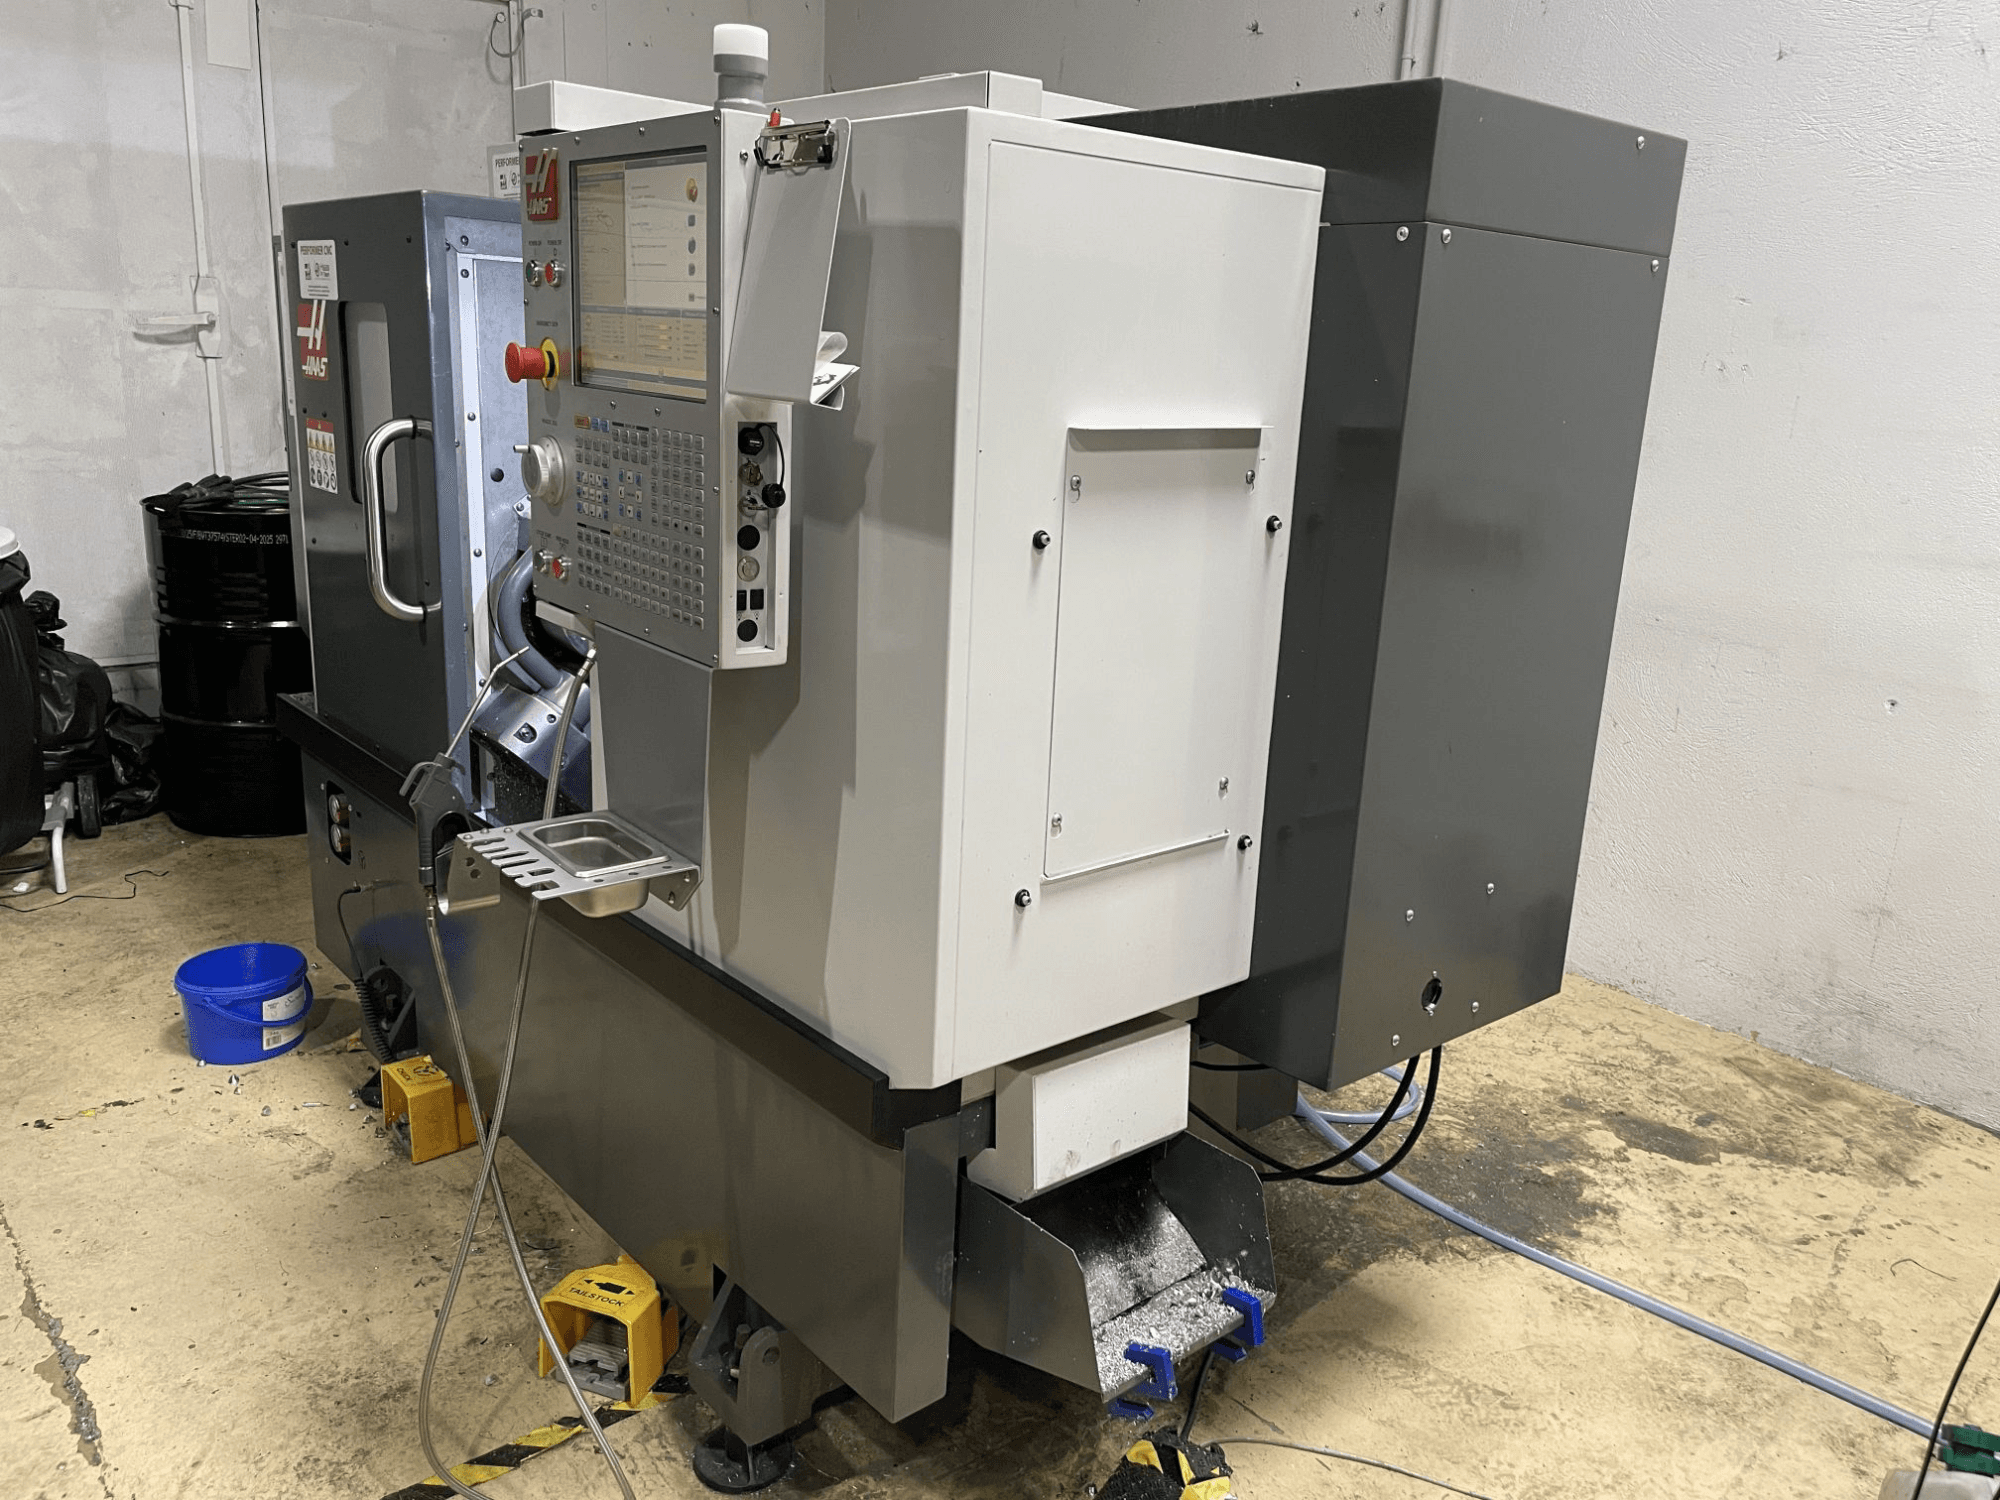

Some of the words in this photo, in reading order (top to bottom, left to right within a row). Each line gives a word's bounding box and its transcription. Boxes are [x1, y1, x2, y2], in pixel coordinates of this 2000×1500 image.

[495, 157, 520, 168] PERFORME
[302, 355, 328, 377] HAAS
[568, 1286, 625, 1308] TAILSTOCK
